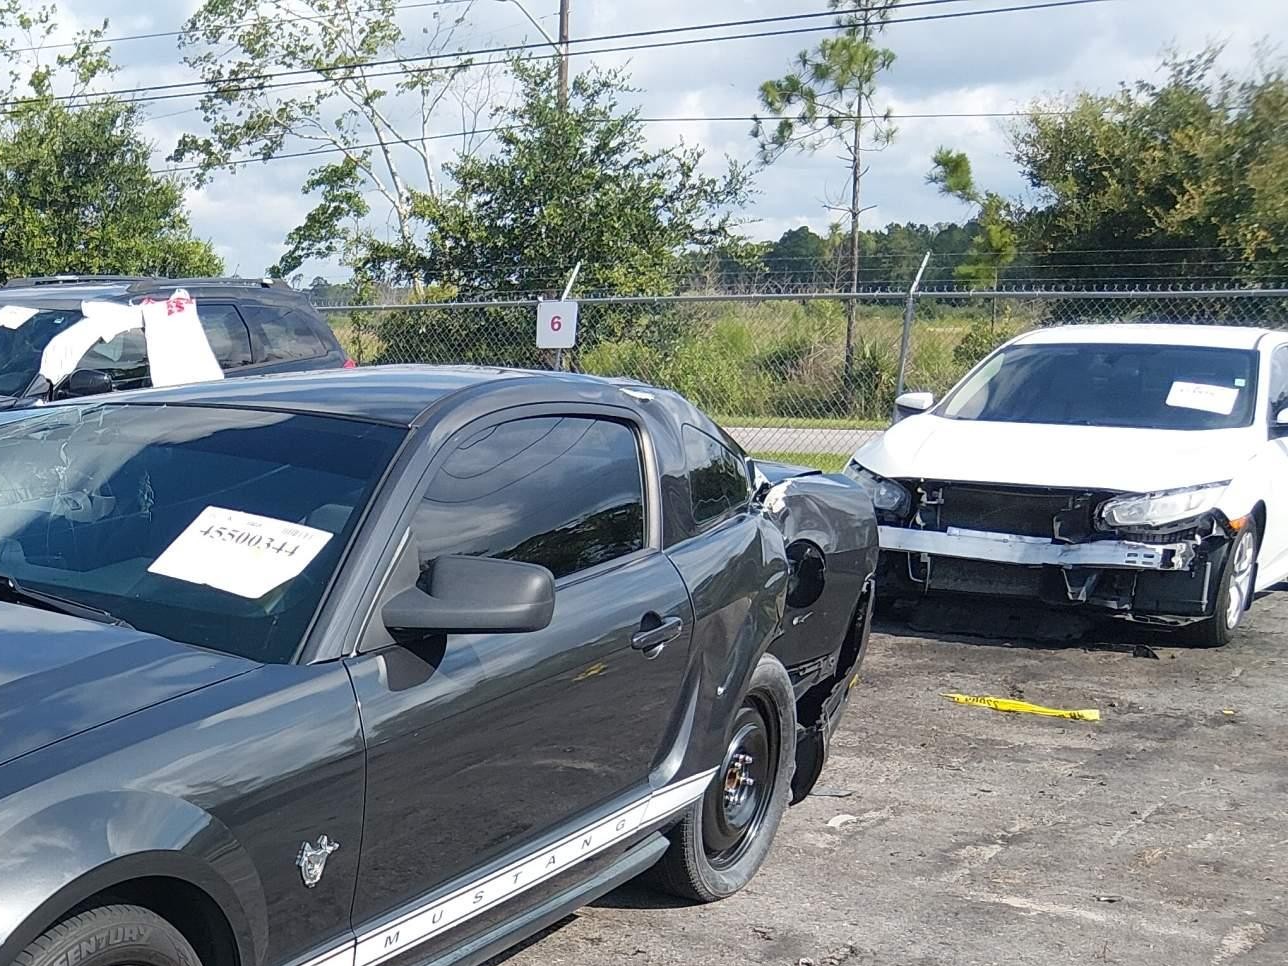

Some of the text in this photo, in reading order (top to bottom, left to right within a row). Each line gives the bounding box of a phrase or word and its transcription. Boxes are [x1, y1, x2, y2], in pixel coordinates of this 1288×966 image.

[551, 315, 562, 331] 6
[199, 524, 301, 557] 45500344
[383, 819, 627, 948] MUSTANG
